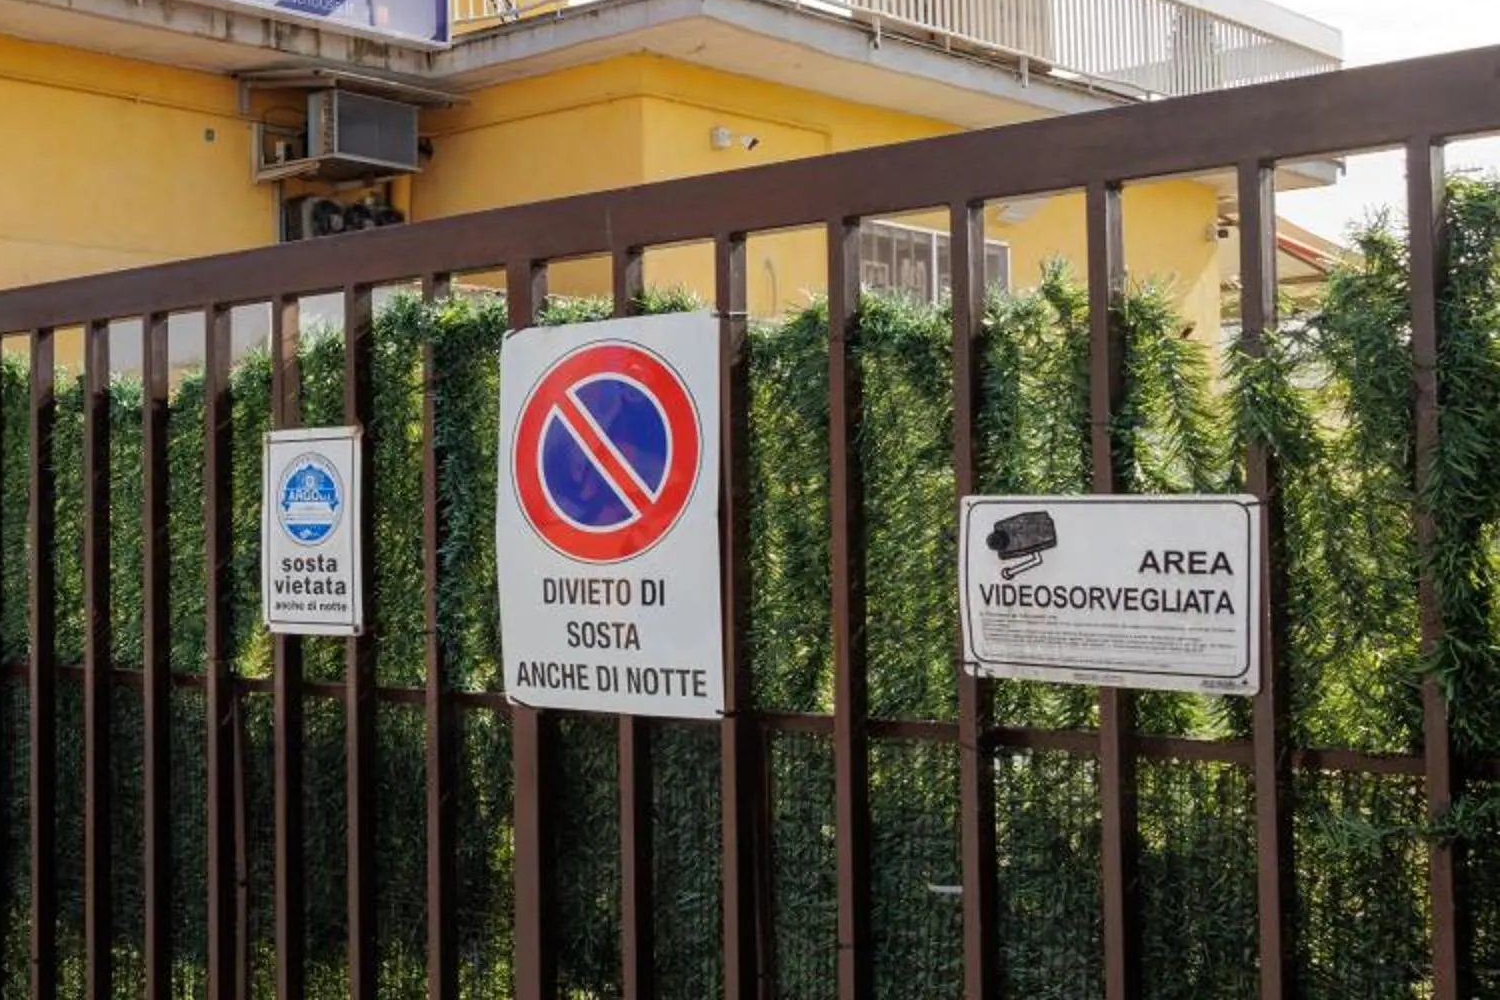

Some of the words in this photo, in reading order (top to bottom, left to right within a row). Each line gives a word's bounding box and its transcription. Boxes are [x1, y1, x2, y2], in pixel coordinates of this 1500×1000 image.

[281, 554, 338, 573] sosta
[1138, 550, 1234, 576] AREA
[274, 575, 347, 596] vietata
[542, 577, 632, 607] DIVIETO
[641, 579, 665, 607] DI
[979, 583, 1235, 615] VIDEOSORVEGLIATA
[307, 600, 316, 611] di
[319, 601, 347, 612] notte
[566, 620, 641, 651] SOSTA
[516, 660, 589, 691] ANCHE
[596, 665, 619, 693] DI
[628, 667, 707, 697] NOTTE
